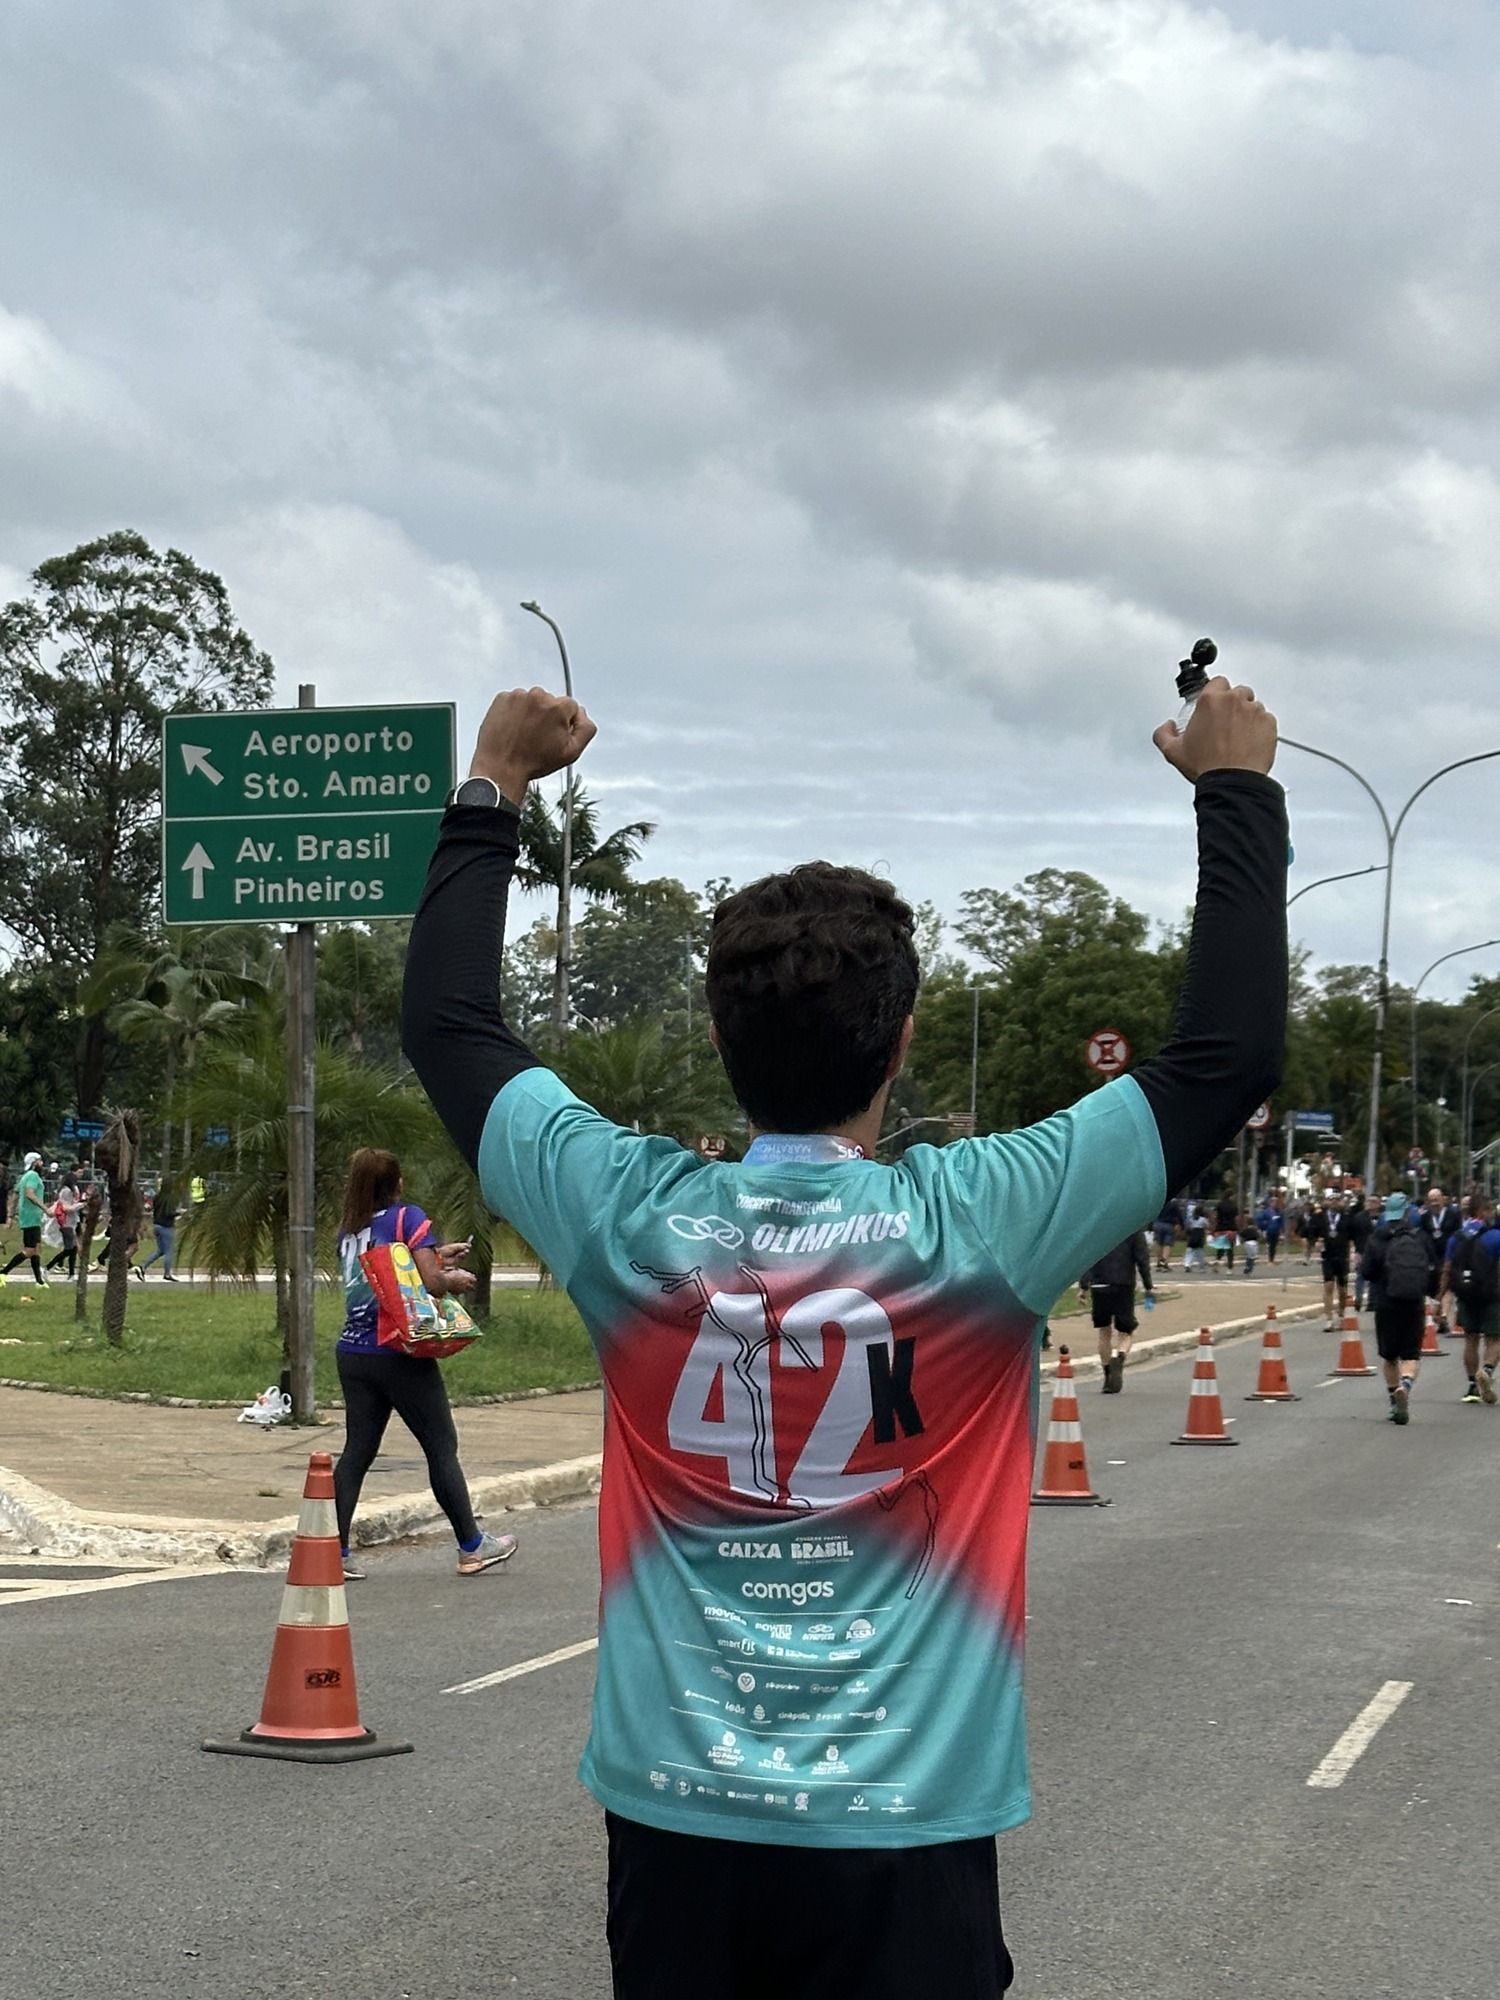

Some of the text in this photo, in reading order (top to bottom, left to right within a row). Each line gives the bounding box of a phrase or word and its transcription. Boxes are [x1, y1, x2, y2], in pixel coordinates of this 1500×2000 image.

[243, 726, 414, 760] Aeroporto
[243, 770, 432, 799] Sto. Amaro
[235, 832, 391, 863] Av. Brasil
[234, 875, 385, 904] Pinheiros
[751, 1211, 911, 1254] OLYMPIKUS
[718, 1540, 854, 1559] CAIXA BRASIL
